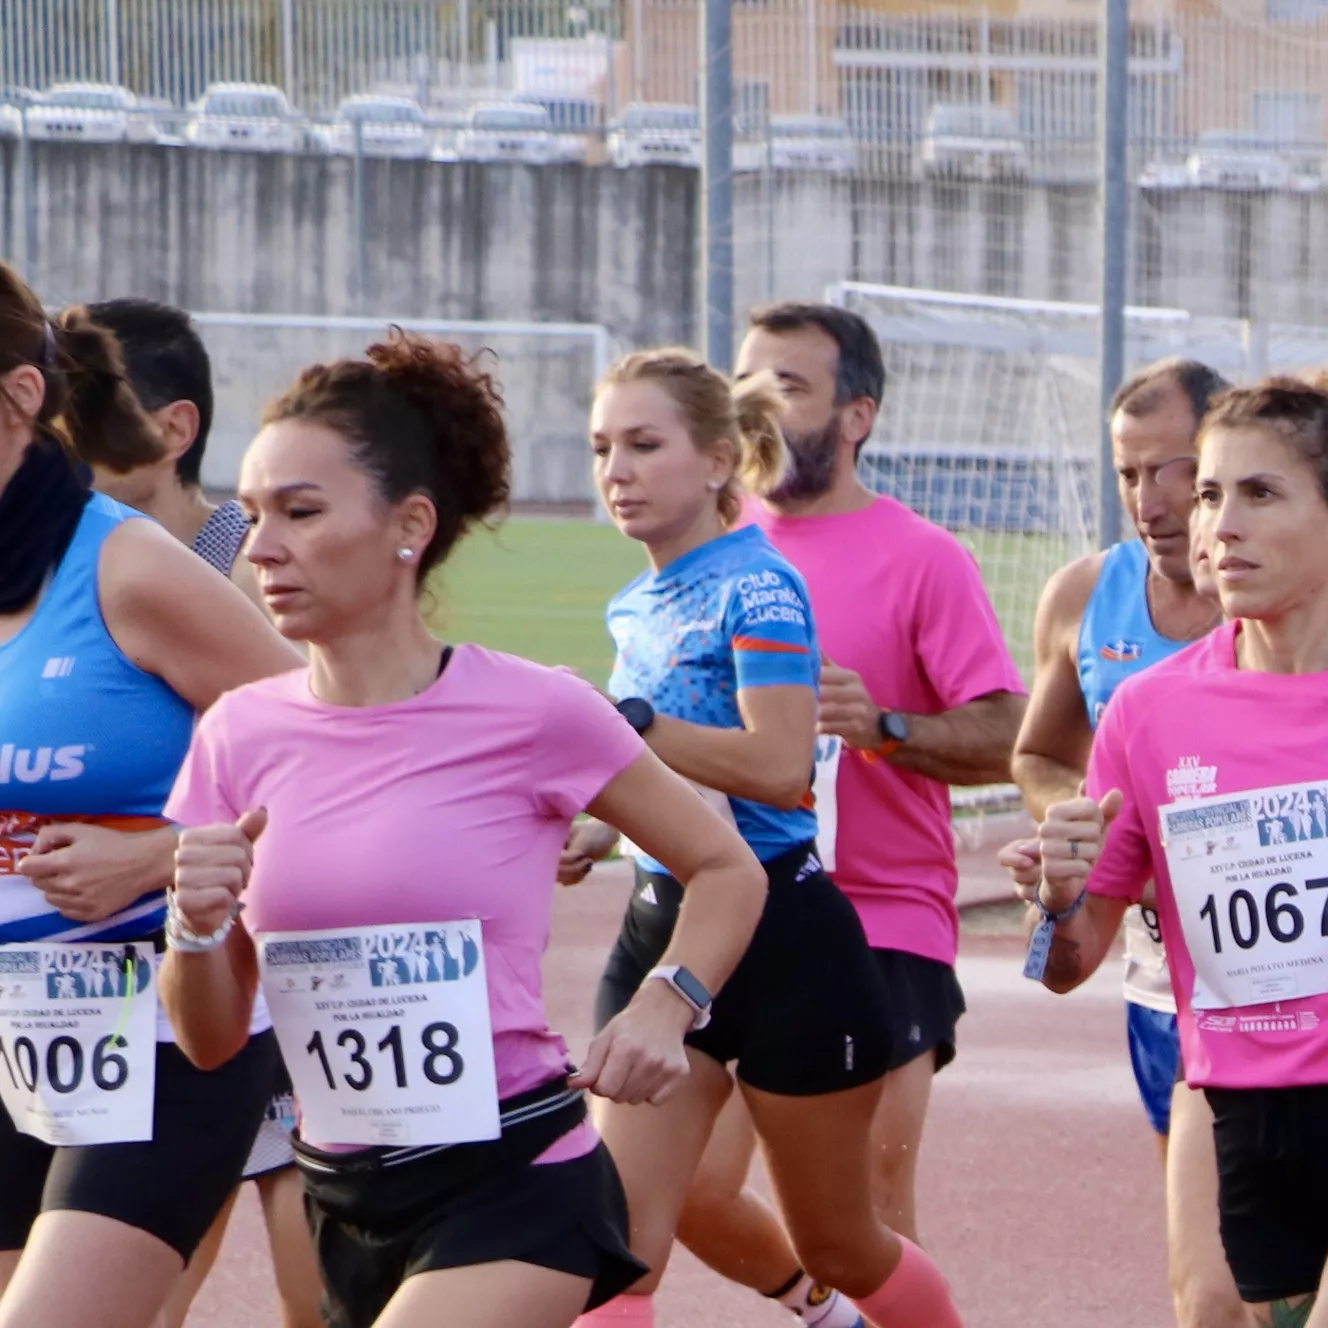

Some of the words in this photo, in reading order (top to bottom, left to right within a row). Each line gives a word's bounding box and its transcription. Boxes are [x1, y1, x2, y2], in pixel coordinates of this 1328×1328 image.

[737, 569, 780, 595] Club
[1252, 791, 1312, 821] 2024
[1266, 855, 1278, 865] DE
[1279, 850, 1314, 864] LUCENA
[1240, 873, 1251, 881] LA
[364, 931, 427, 959] 2024
[40, 950, 105, 973] 2024
[0, 1032, 130, 1094] 1006
[306, 1021, 464, 1092] 1318
